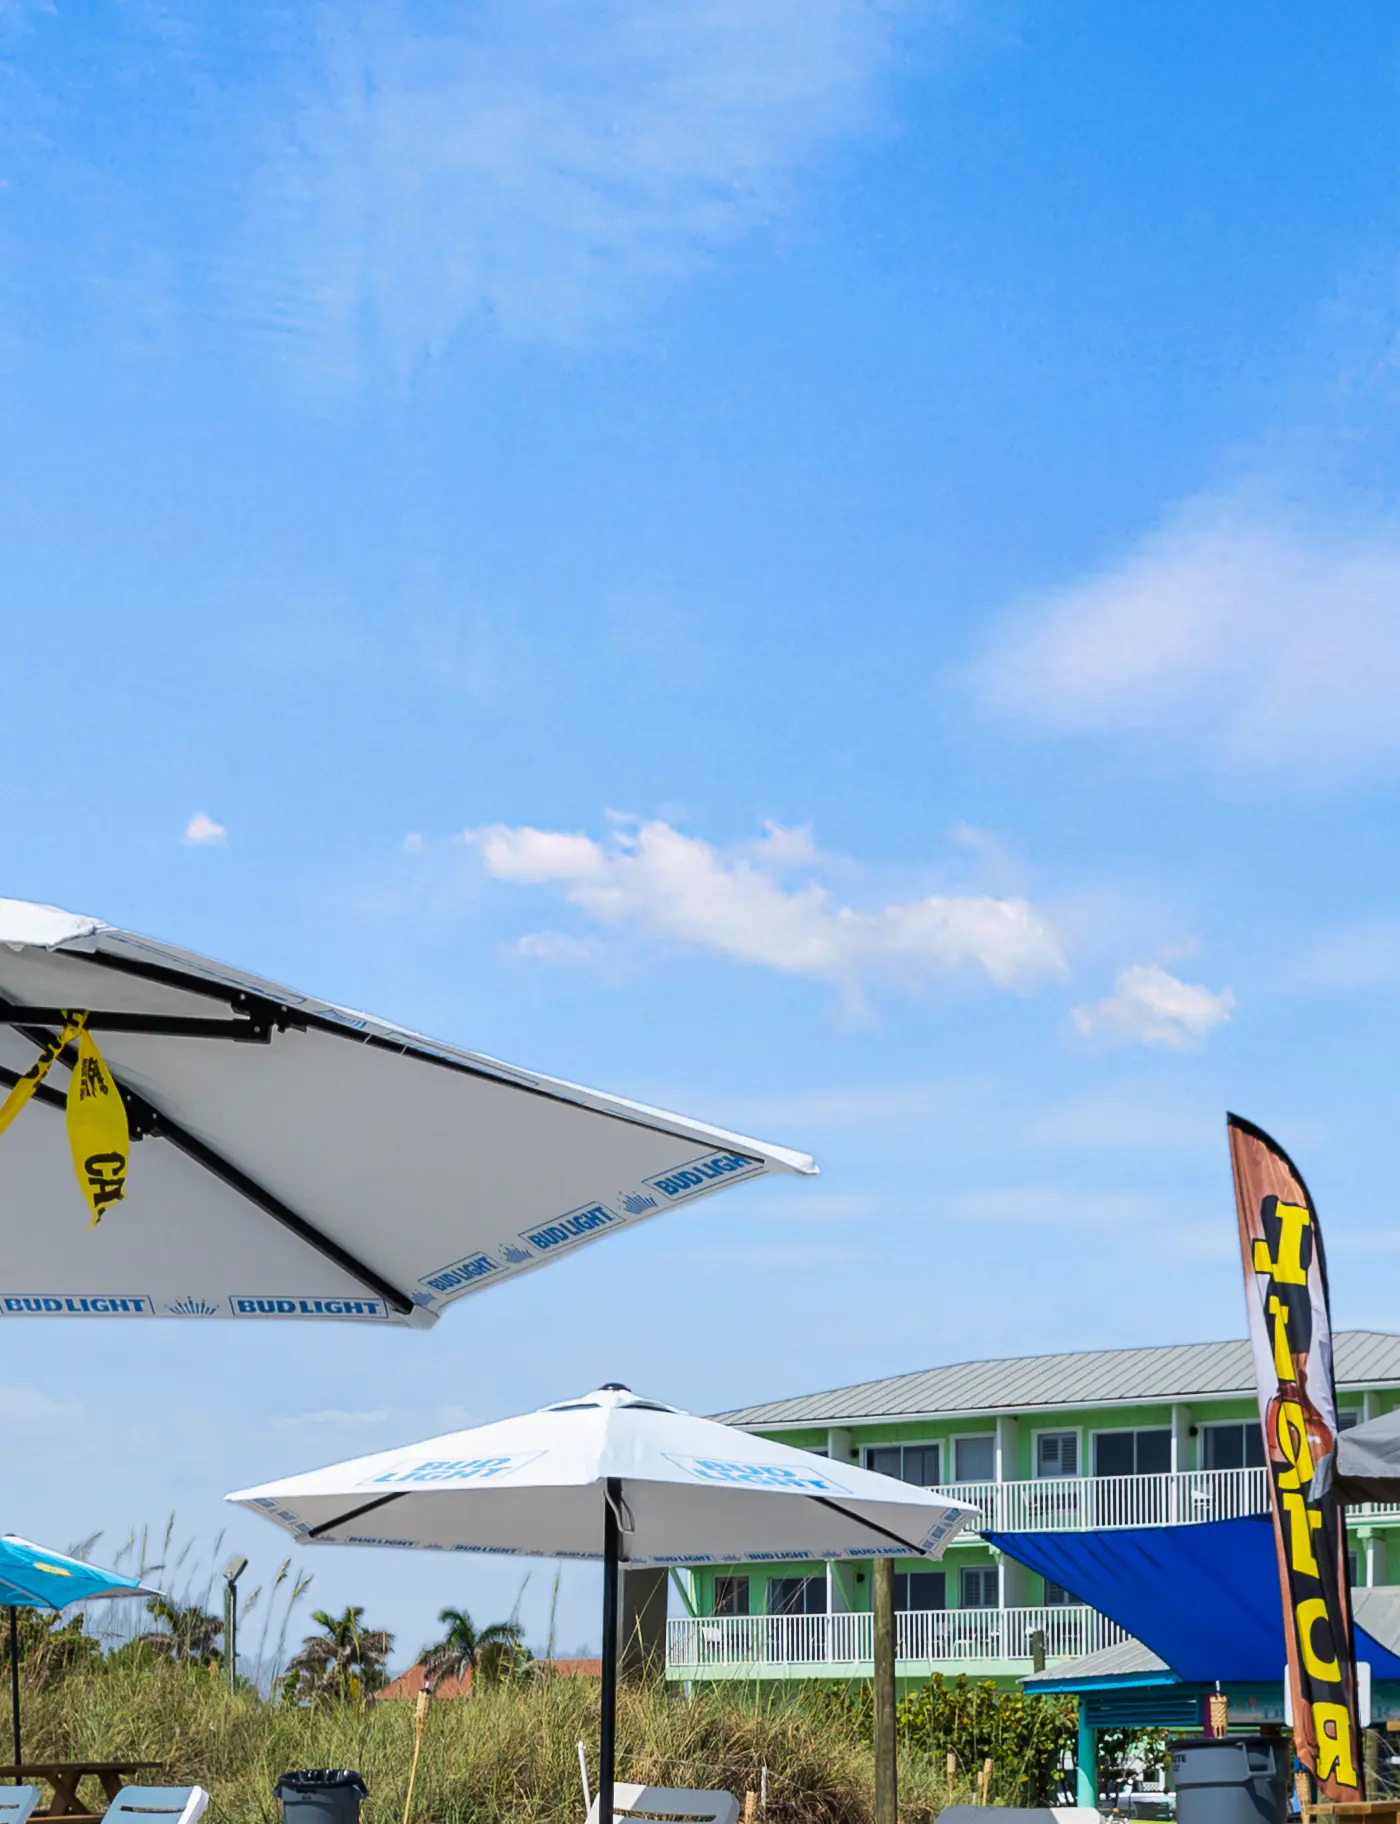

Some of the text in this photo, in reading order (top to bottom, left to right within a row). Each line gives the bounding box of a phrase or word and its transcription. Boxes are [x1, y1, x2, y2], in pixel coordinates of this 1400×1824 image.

[653, 1152, 753, 1195] BUD LIGH
[84, 1151, 126, 1223] CA
[527, 1206, 613, 1249] BUD LIGHT
[427, 1256, 497, 1291] BUD LIGHT
[4, 1298, 145, 1312] BUD LIGHT
[237, 1300, 379, 1314] BUD LIGHT
[414, 1457, 512, 1471] BUD
[694, 1459, 797, 1477] BUD
[373, 1466, 512, 1482] LIGHT
[693, 1468, 831, 1489] LIGHT
[774, 1551, 809, 1559] LIGHT
